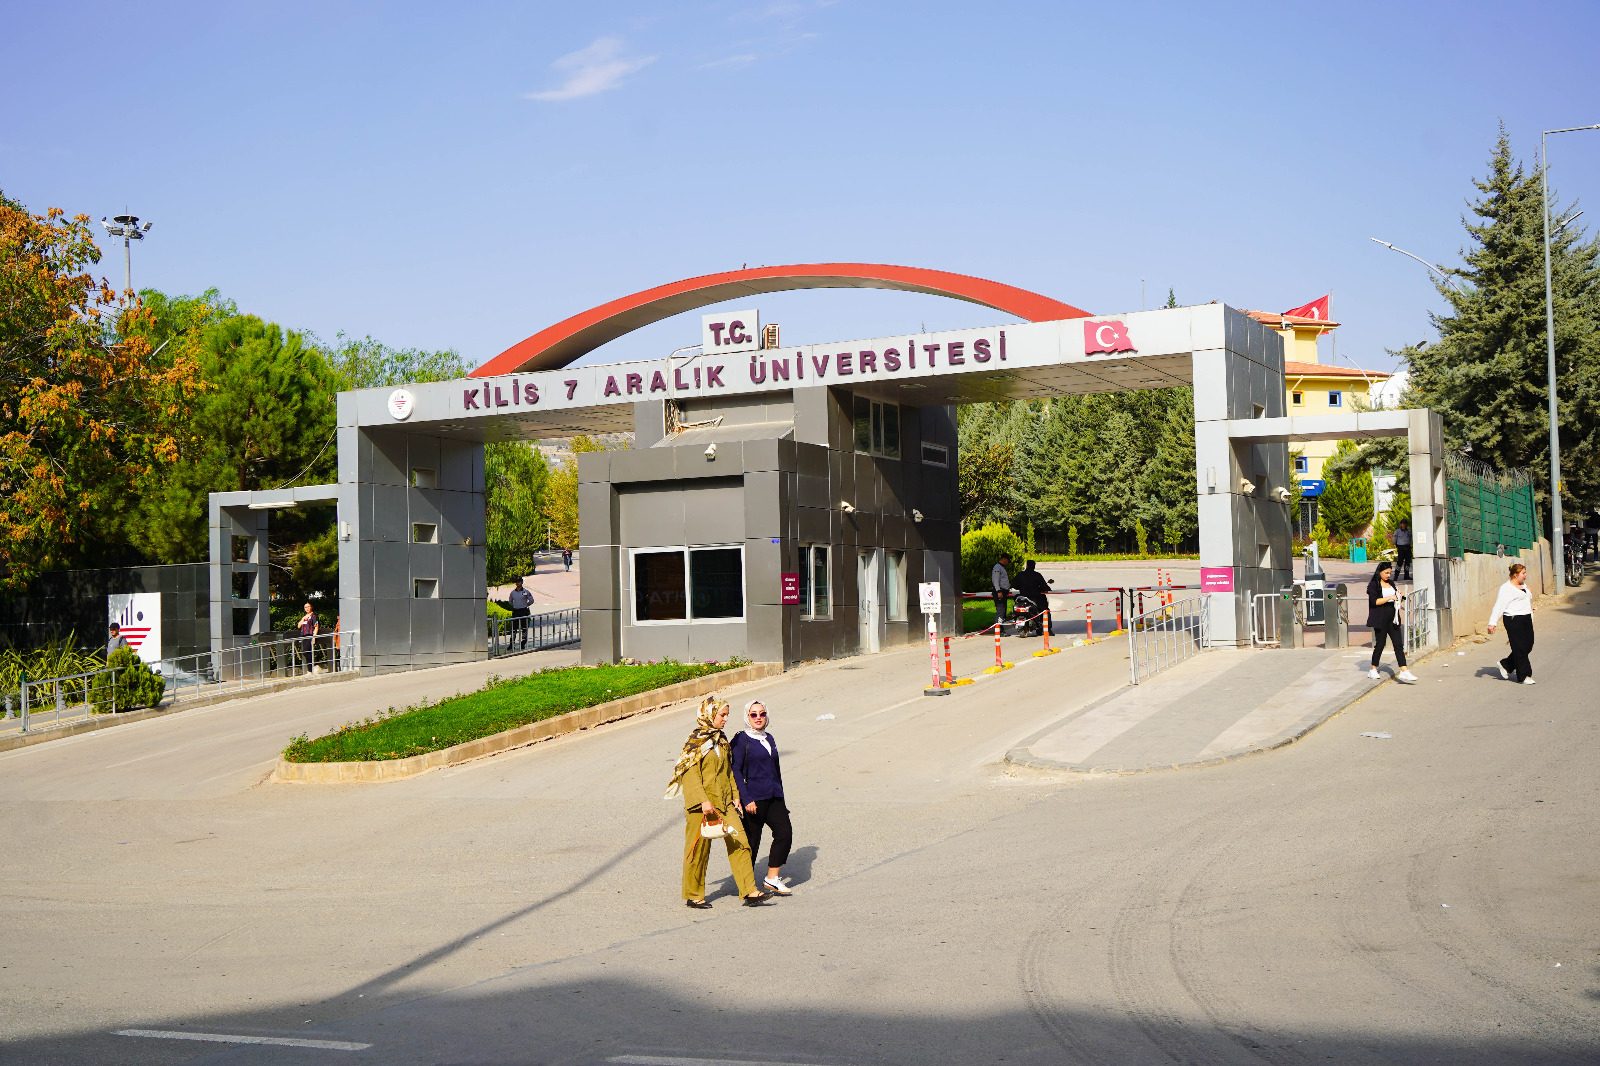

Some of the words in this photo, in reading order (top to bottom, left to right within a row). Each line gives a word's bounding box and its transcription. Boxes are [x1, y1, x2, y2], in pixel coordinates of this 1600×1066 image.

[709, 320, 752, 346] T.C.
[463, 378, 540, 410] KİLİS
[564, 379, 578, 400] 7
[604, 365, 725, 398] ARALIK
[749, 330, 1007, 384] ÜNİVERSİTESİ
